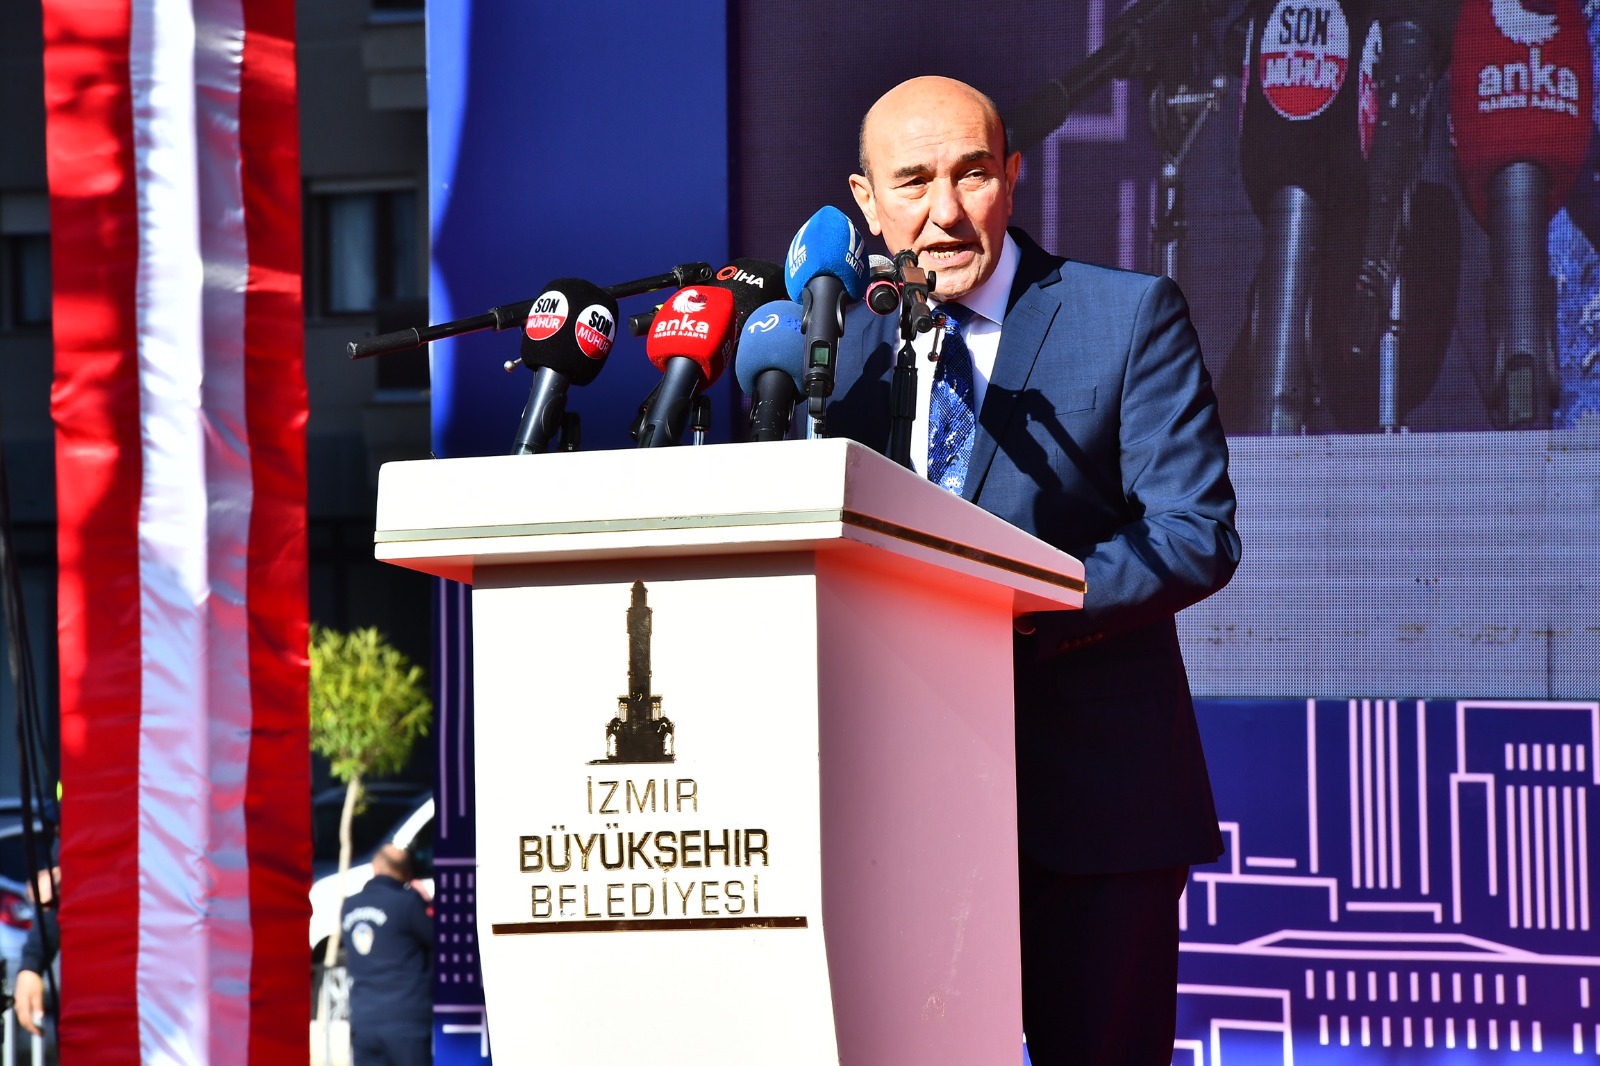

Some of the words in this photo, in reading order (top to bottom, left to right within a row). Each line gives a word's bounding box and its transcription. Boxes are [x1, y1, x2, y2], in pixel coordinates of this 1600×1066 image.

[1279, 6, 1330, 46] SON
[1478, 46, 1579, 101] anka
[535, 298, 561, 314] SON
[526, 315, 561, 330] MÜHÜR
[588, 310, 613, 338] SON
[655, 314, 709, 335] anka
[531, 874, 759, 918] BELEDİYESİ
